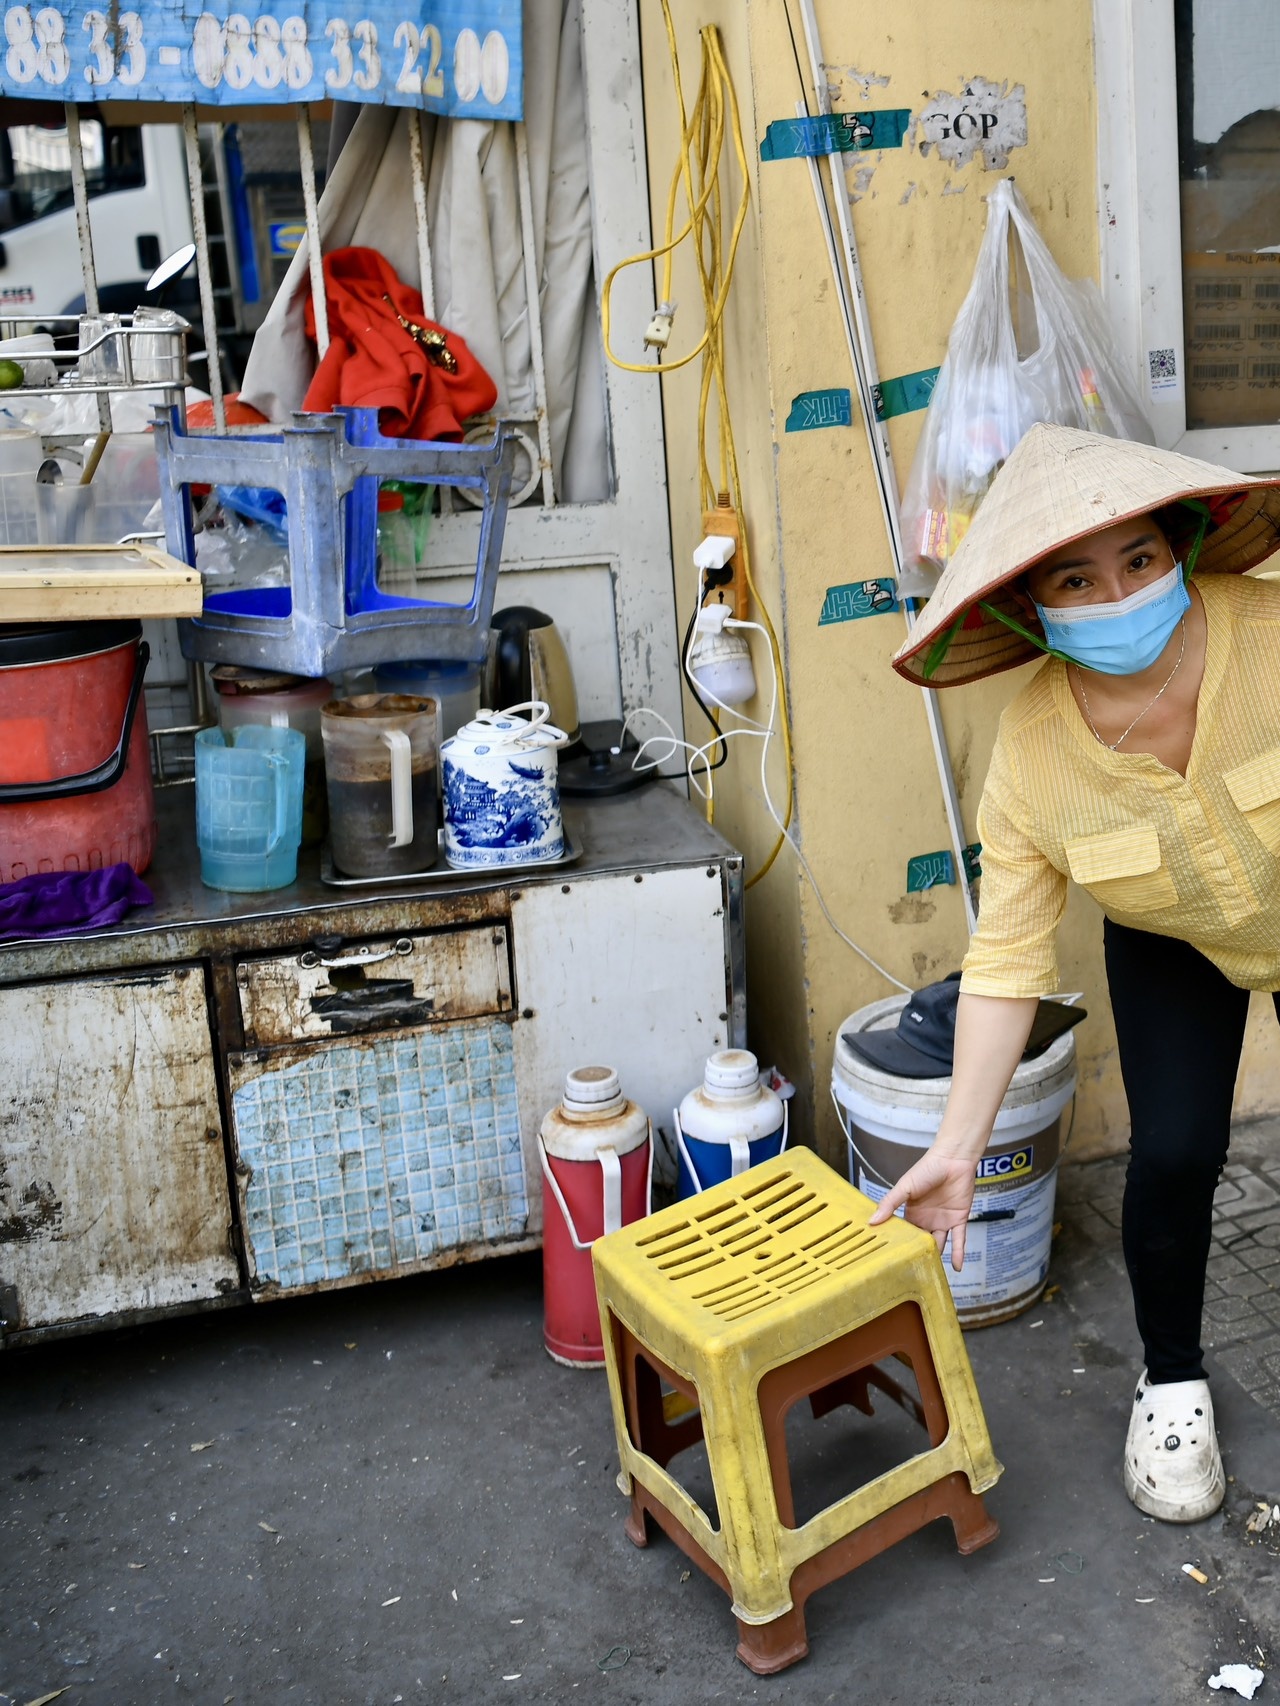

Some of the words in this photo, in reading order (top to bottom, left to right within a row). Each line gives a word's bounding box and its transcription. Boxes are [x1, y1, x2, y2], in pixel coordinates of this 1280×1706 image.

[4, 5, 70, 84] 88
[82, 10, 146, 85] 33
[193, 11, 312, 89] 0888
[325, 18, 381, 89] 33
[393, 21, 444, 97] 22
[454, 27, 509, 104] 00
